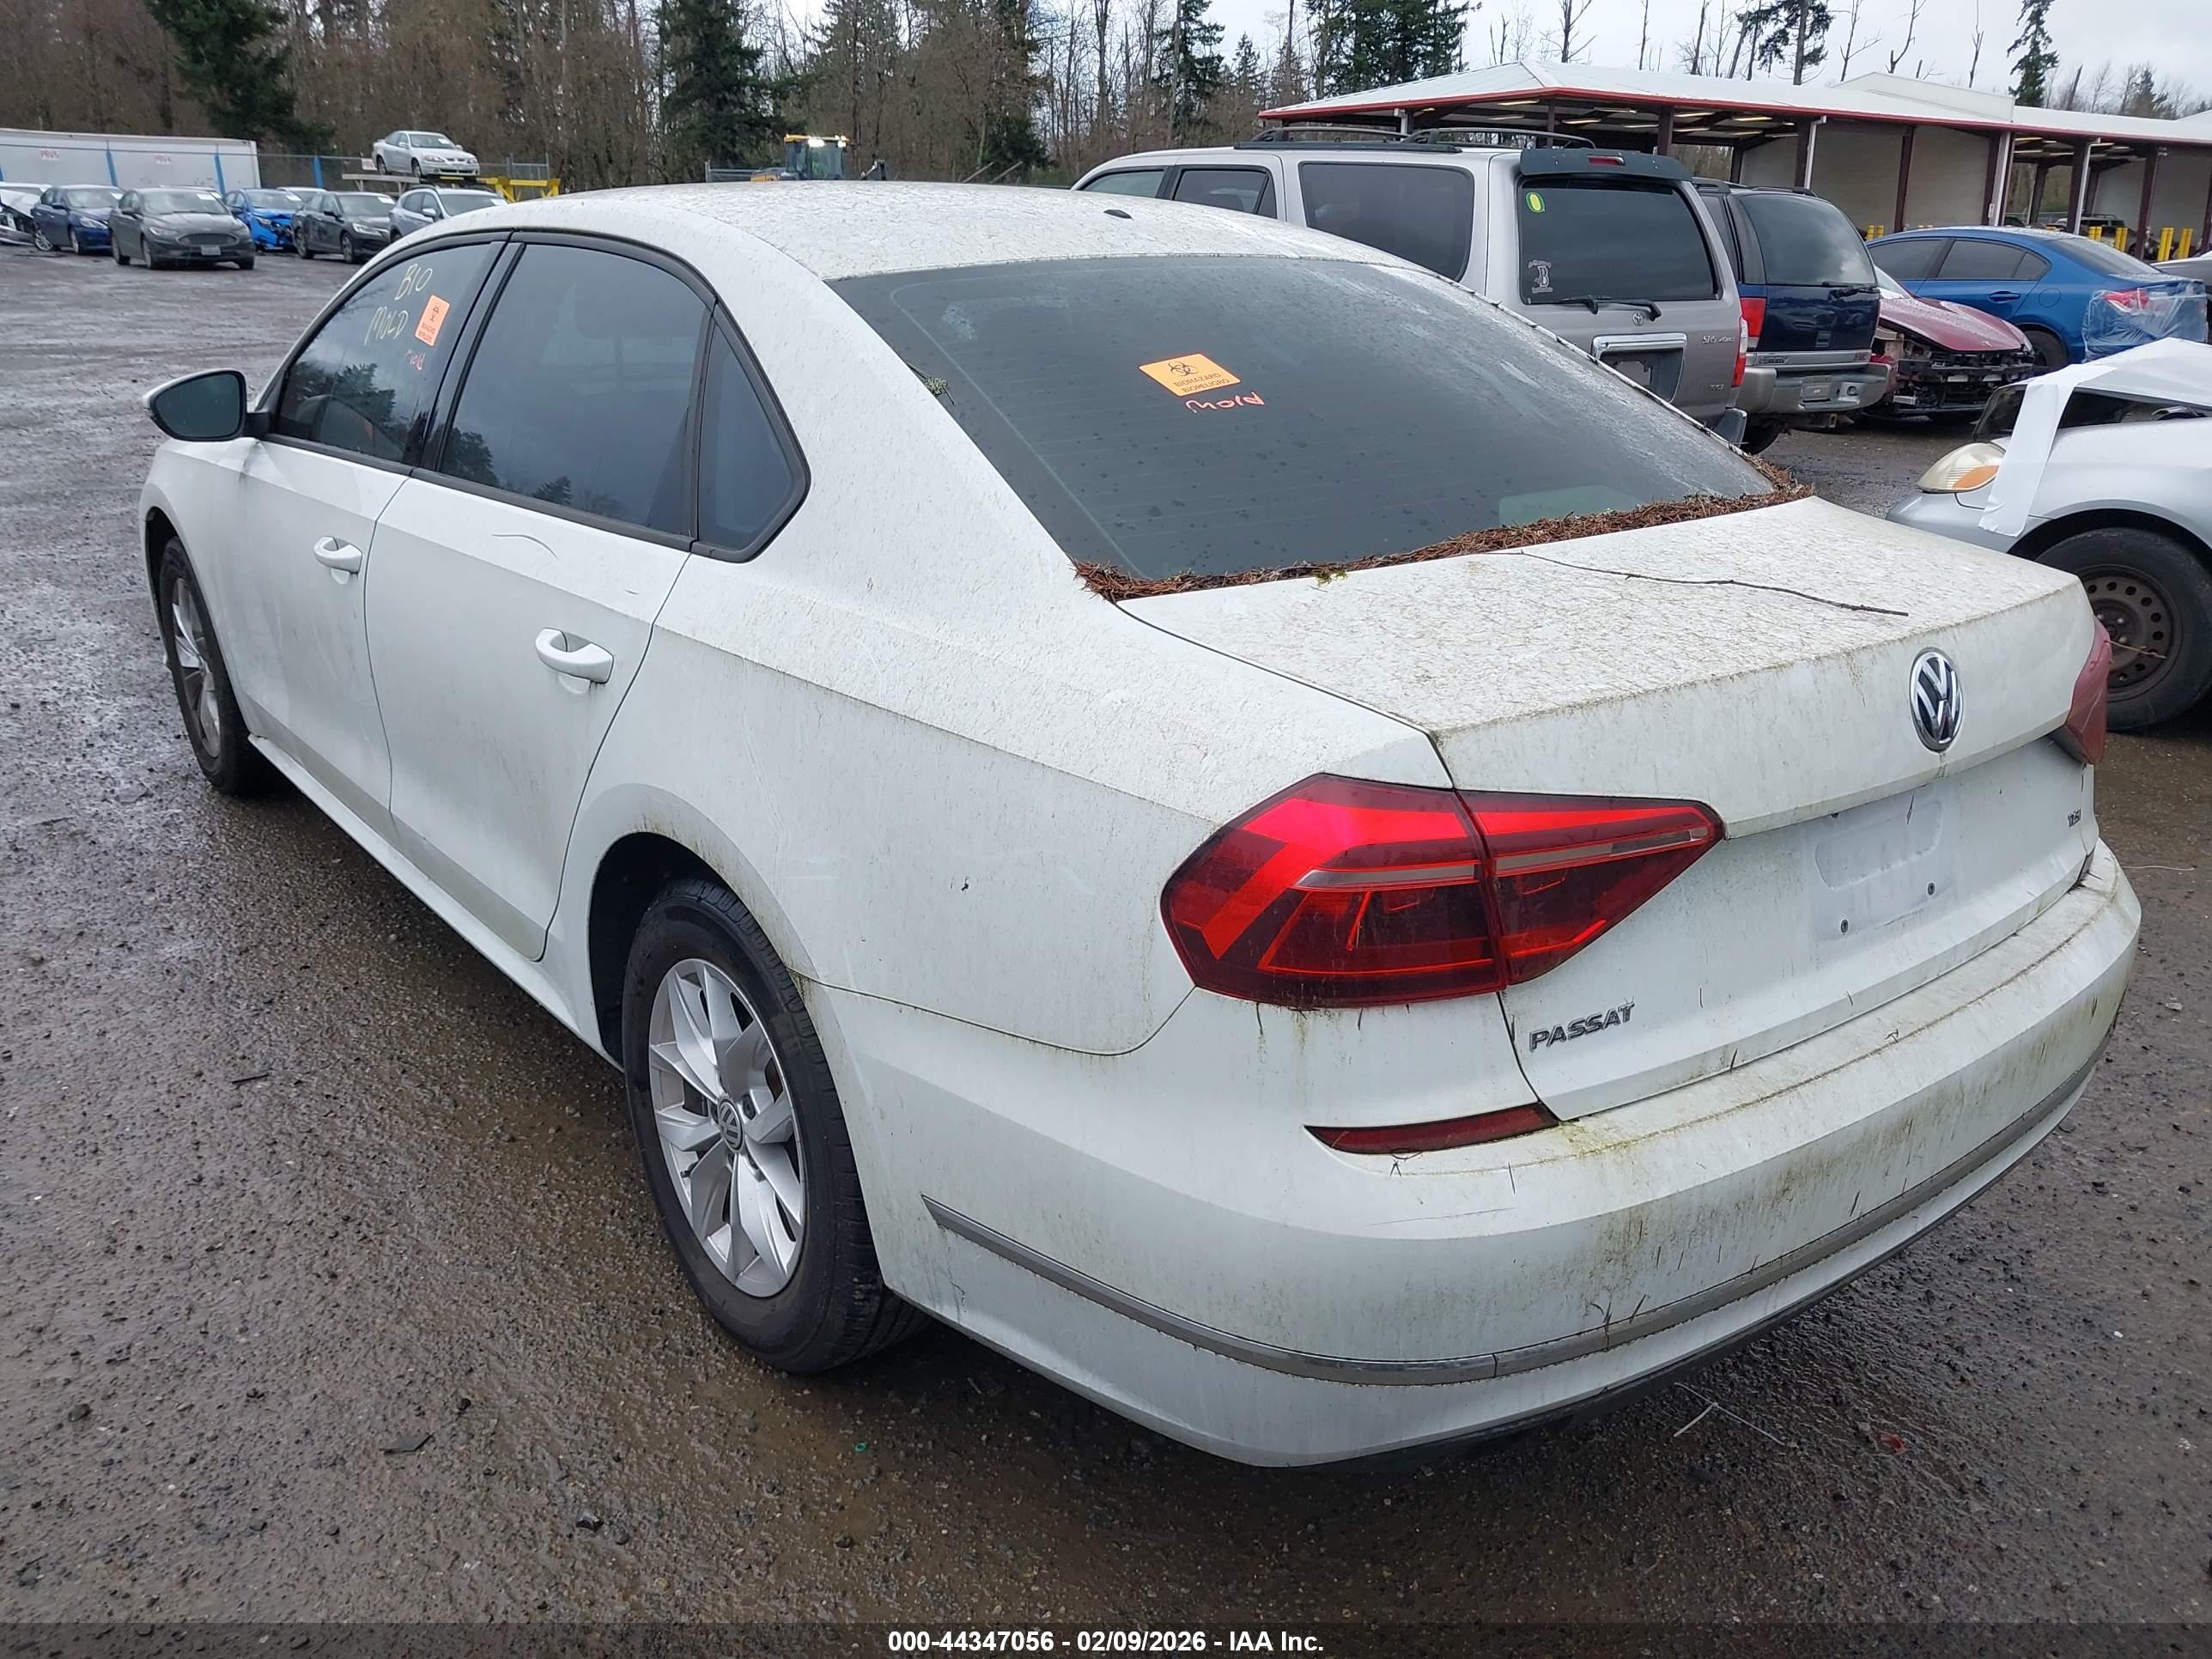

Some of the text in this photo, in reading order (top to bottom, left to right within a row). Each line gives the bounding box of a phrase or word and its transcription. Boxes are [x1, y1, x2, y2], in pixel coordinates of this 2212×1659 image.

[394, 263, 433, 301] BIO
[1173, 373, 1222, 387] BIOHAZARD
[1182, 378, 1231, 392] BIOPELIGRO
[1529, 1002, 1635, 1052] PASSAT
